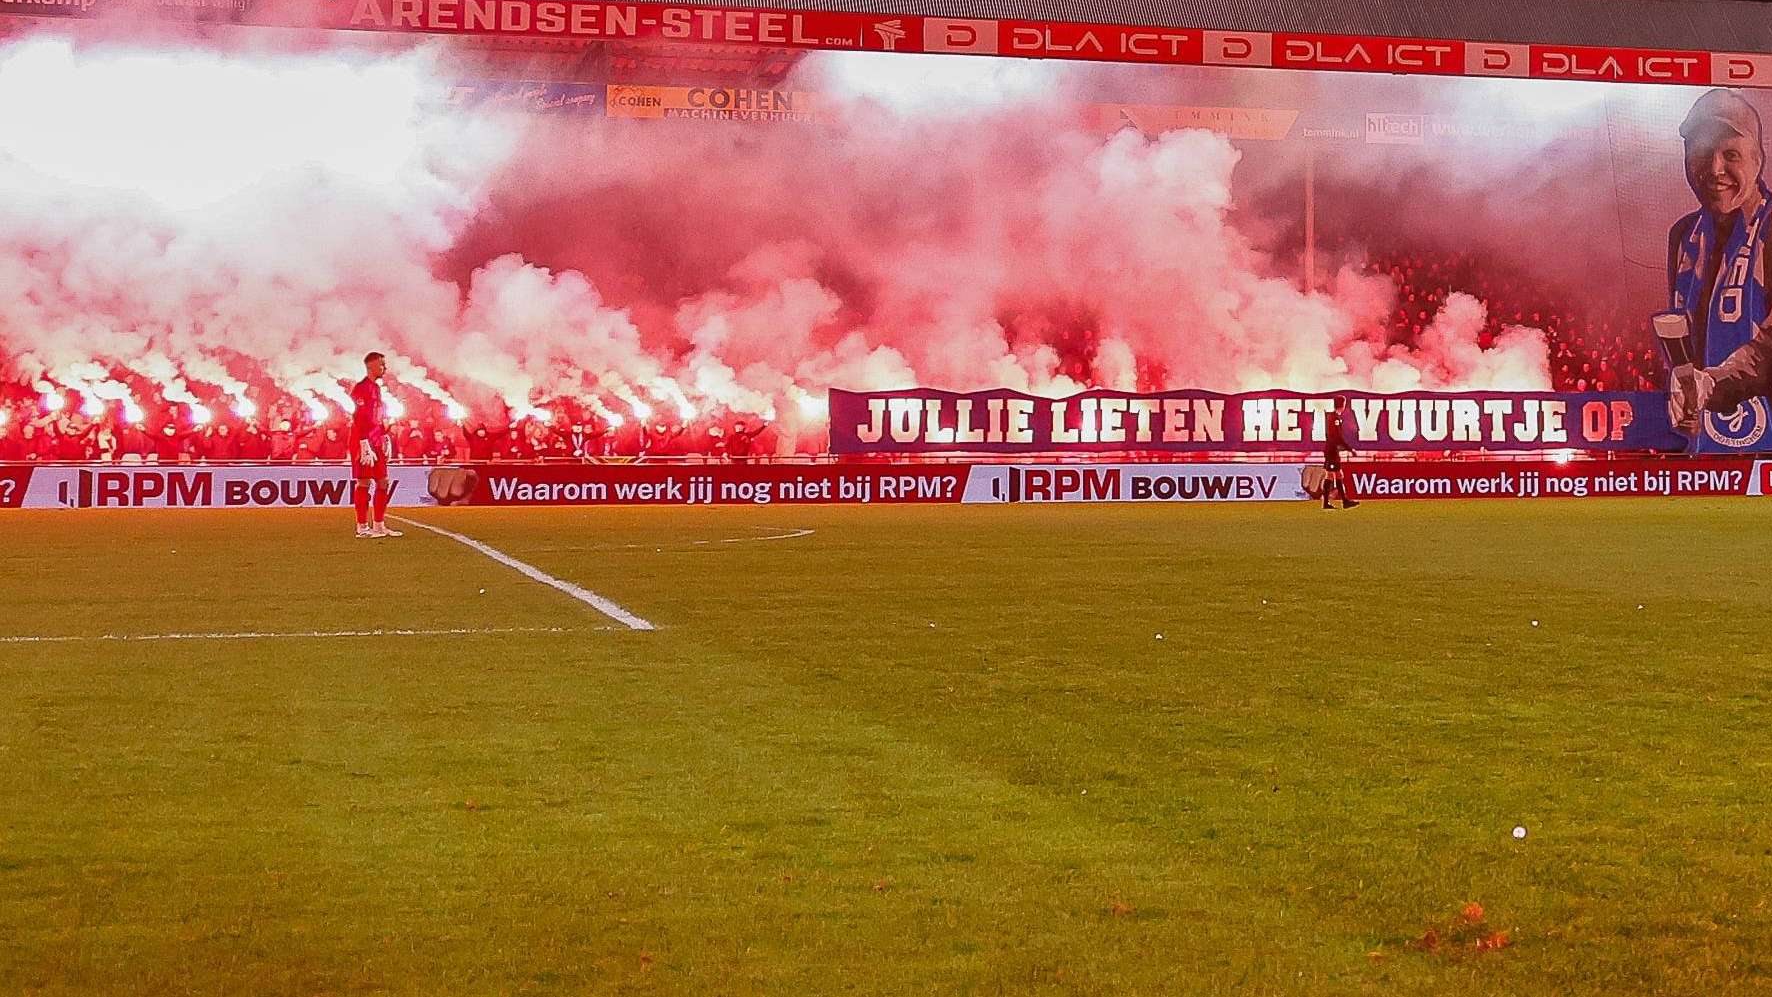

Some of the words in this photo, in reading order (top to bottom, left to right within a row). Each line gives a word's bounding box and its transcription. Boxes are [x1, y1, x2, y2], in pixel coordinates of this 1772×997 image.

[1013, 27, 1103, 53] DLA
[1120, 33, 1188, 56] ICT
[1285, 40, 1372, 64] DLA
[1388, 45, 1451, 67] ICT
[1542, 53, 1623, 76] DLA
[1638, 57, 1698, 78] ICT
[687, 88, 793, 110] COHEN
[857, 398, 1034, 443] JULLIE
[1051, 398, 1225, 442] LIETEN
[1242, 398, 1335, 442] HET
[1351, 398, 1569, 442] VUURTJE
[1580, 400, 1634, 441] OP
[100, 472, 213, 506] RPM
[488, 476, 607, 501] Waarom
[614, 476, 683, 500] werk
[688, 476, 713, 504] jij
[721, 482, 771, 504] nog
[779, 476, 832, 500] niet
[839, 476, 871, 503] bij
[879, 476, 957, 500] RPM?
[1024, 468, 1121, 501] RPM
[1353, 472, 1451, 495] Waarom
[1457, 472, 1514, 494] werk
[1517, 471, 1539, 497] jij
[1545, 477, 1588, 497] nog
[1594, 471, 1639, 493] niet
[1644, 470, 1671, 494] bij
[1677, 470, 1744, 491] RPM?
